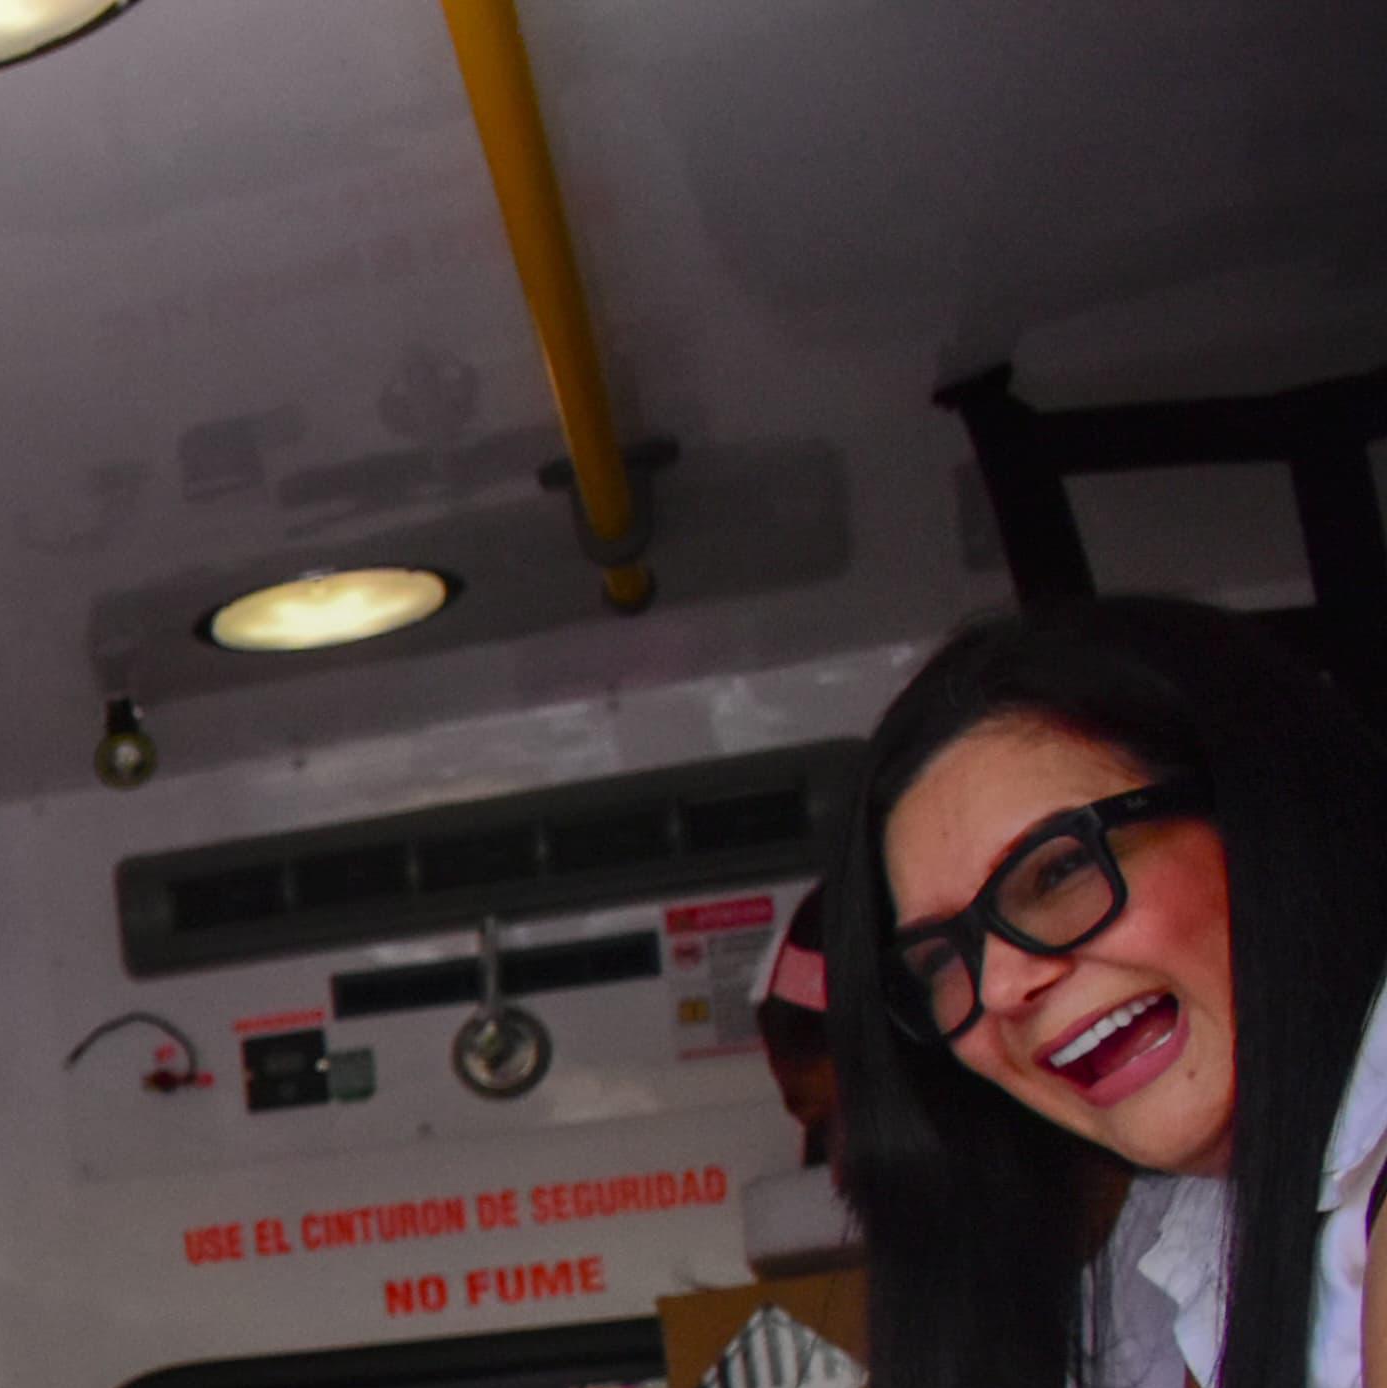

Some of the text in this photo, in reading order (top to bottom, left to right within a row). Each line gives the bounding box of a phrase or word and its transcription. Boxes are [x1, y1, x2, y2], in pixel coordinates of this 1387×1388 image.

[184, 1165, 728, 1264] USE EL CINTURON DE SEGURIDAD
[384, 1255, 607, 1318] NO FUME
